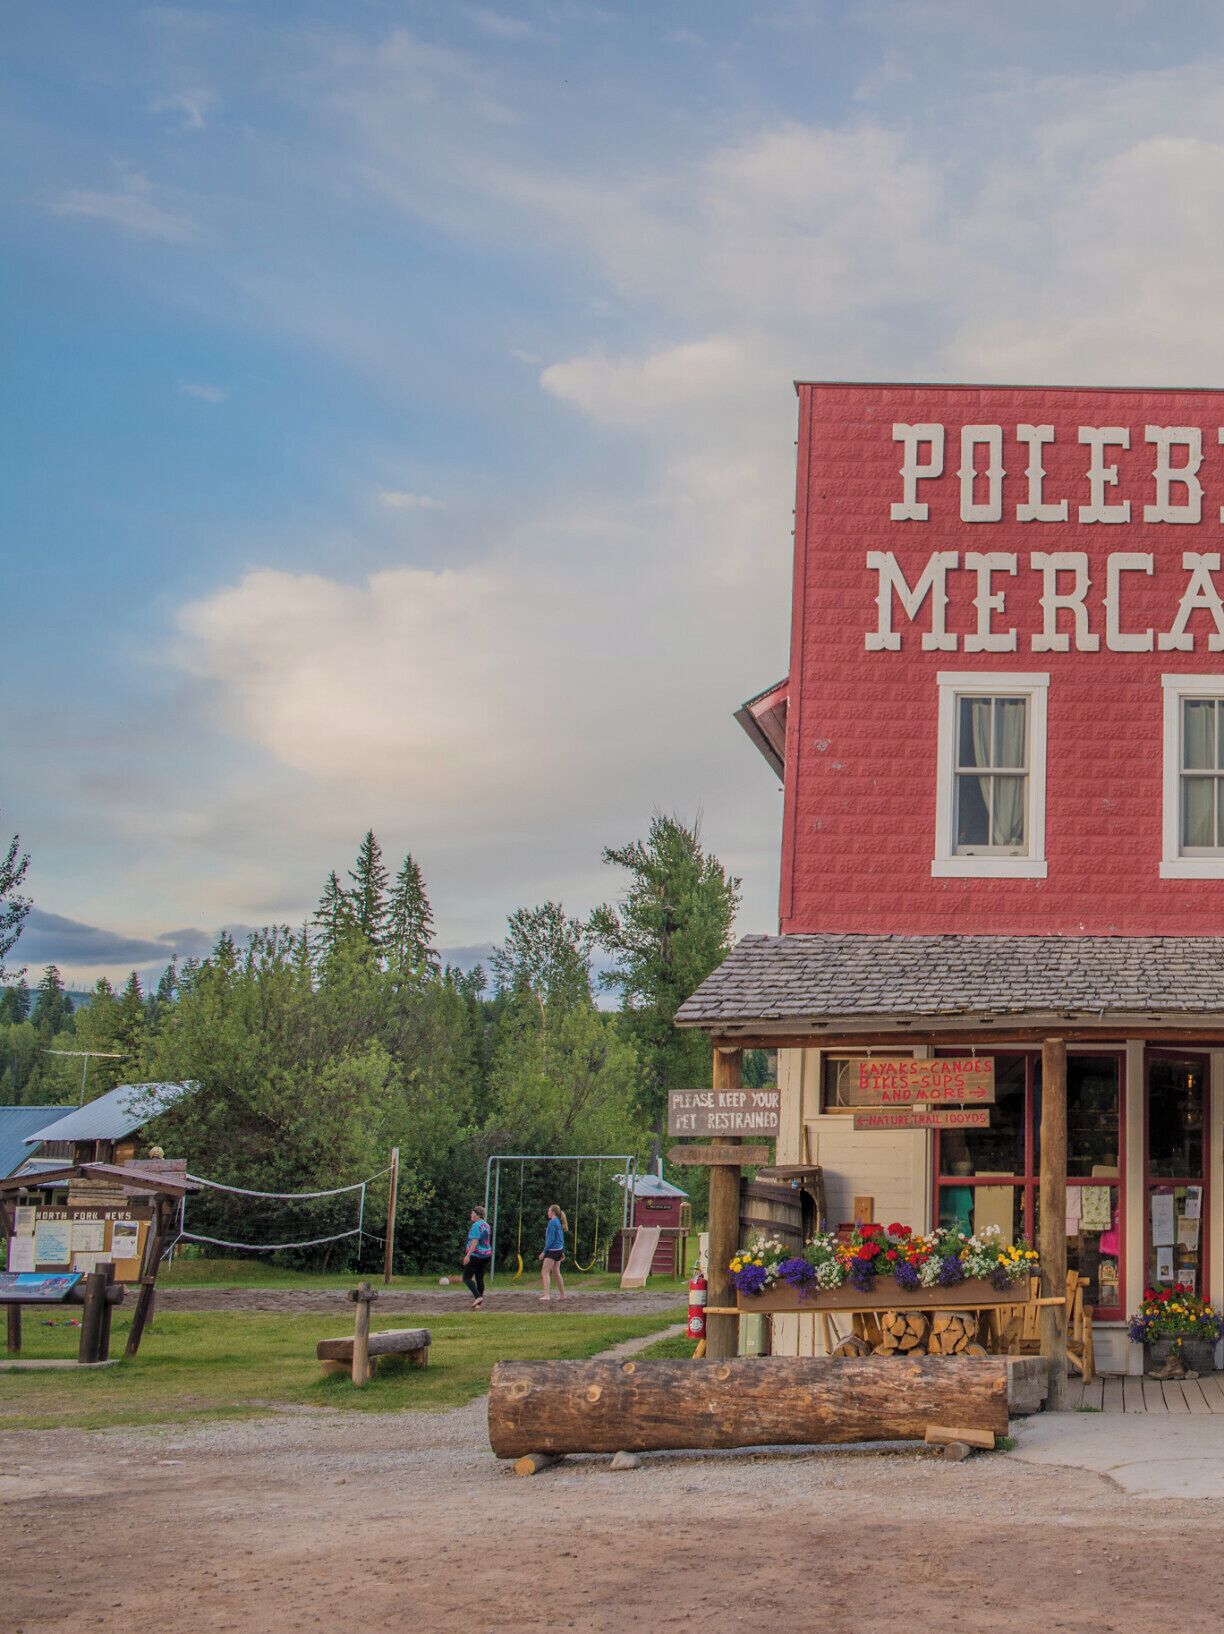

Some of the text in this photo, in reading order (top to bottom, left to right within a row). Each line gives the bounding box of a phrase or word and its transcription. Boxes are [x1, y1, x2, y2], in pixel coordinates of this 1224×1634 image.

[672, 1092, 779, 1109] PLEASE KEEP YOUR
[881, 1087, 965, 1101] AND MORE
[676, 1111, 778, 1129] PET RESTRAINED
[869, 1114, 911, 1126] NATURE
[911, 1112, 942, 1125] TRAIL
[36, 1211, 132, 1220] NORTH FORK NEWS
